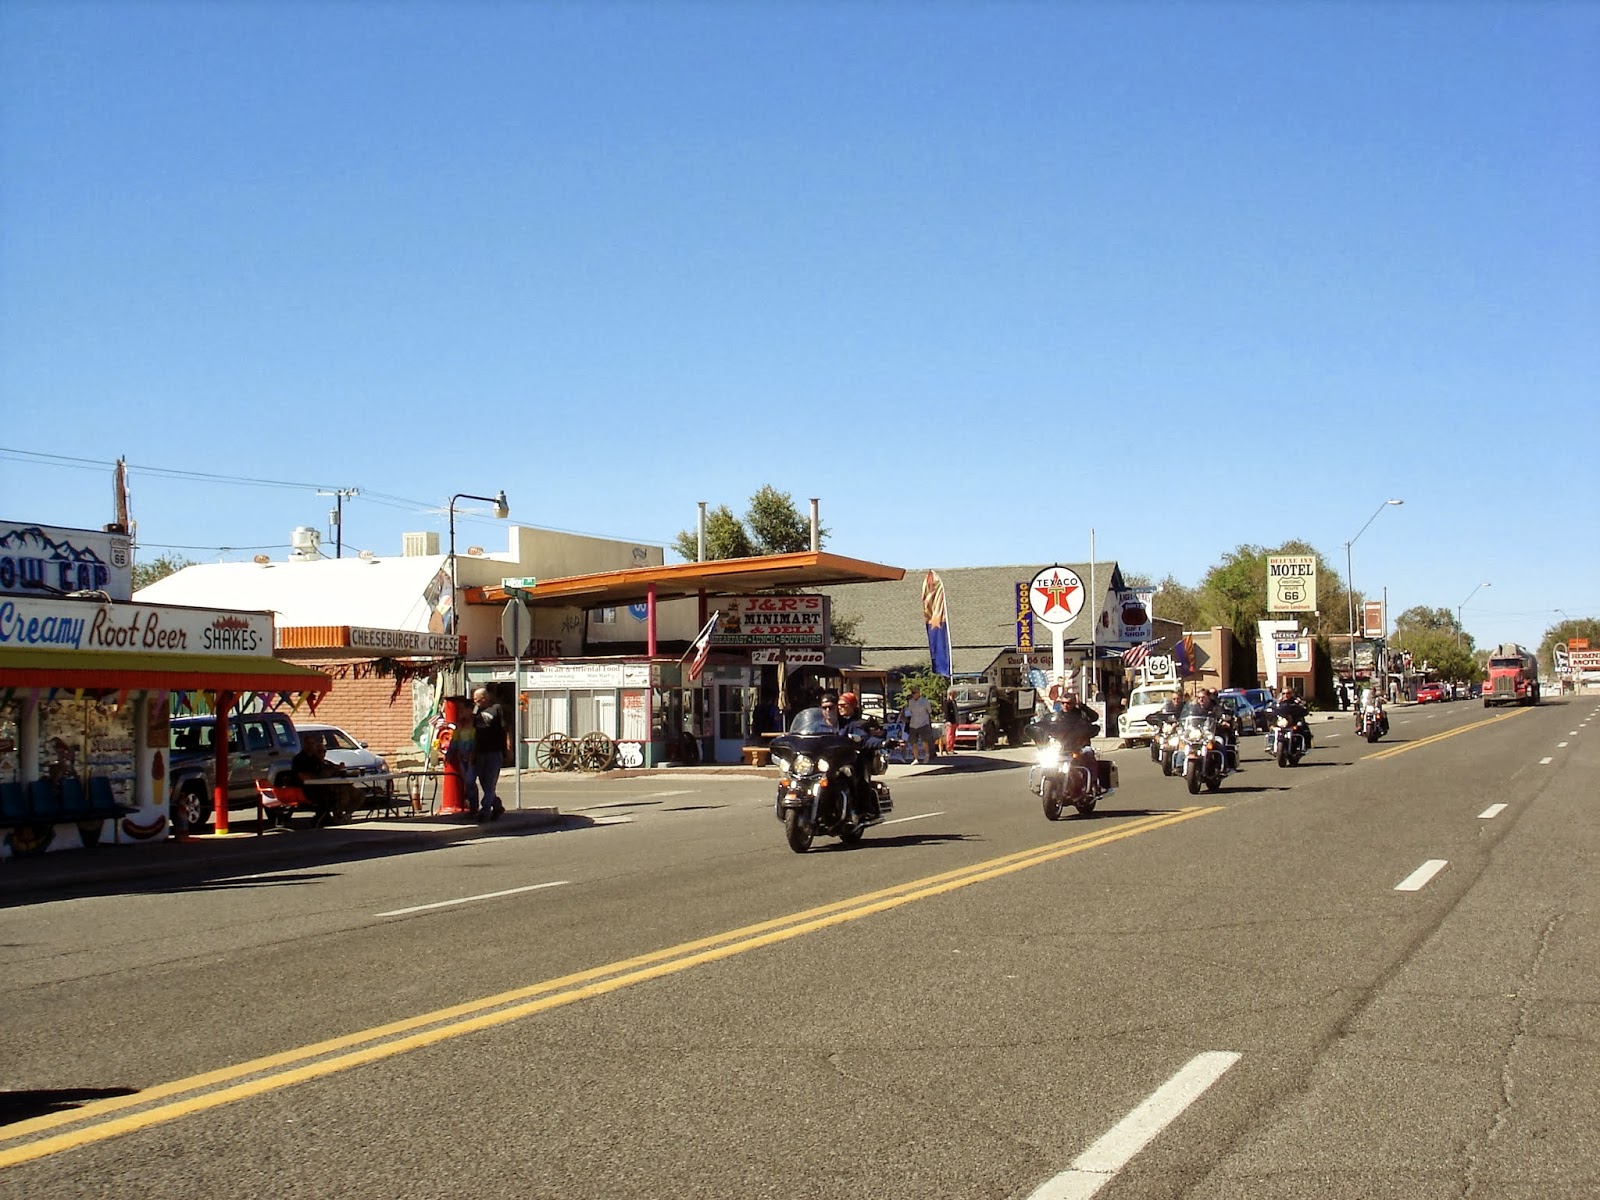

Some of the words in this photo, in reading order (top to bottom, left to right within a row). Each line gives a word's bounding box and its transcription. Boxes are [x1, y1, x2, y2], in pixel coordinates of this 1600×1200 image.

[114, 554, 125, 564] 66
[59, 560, 111, 591] CAP
[1270, 564, 1313, 576] MOTEL
[1036, 578, 1078, 586] TEXACO
[1284, 591, 1299, 600] 66
[746, 599, 818, 611] J&R'S
[744, 613, 821, 625] MINIMART
[1018, 583, 1031, 646] GOODYEAR
[0, 601, 85, 650] Creamy
[88, 608, 141, 646] Root
[142, 611, 188, 649] Beer
[203, 626, 257, 651] SHAKES
[768, 625, 815, 634] DELI
[352, 629, 420, 650] CHEESEBURGER
[428, 636, 458, 652] CHEESE
[752, 635, 776, 644] LUNCH
[780, 635, 822, 644] SOUVENIRS
[495, 637, 562, 656] GERIES
[1007, 656, 1027, 665] Rout
[1028, 656, 1039, 665] 66
[1150, 659, 1167, 671] 66
[572, 664, 601, 673] Oriental
[603, 663, 620, 672] Food
[623, 754, 636, 765] 66
